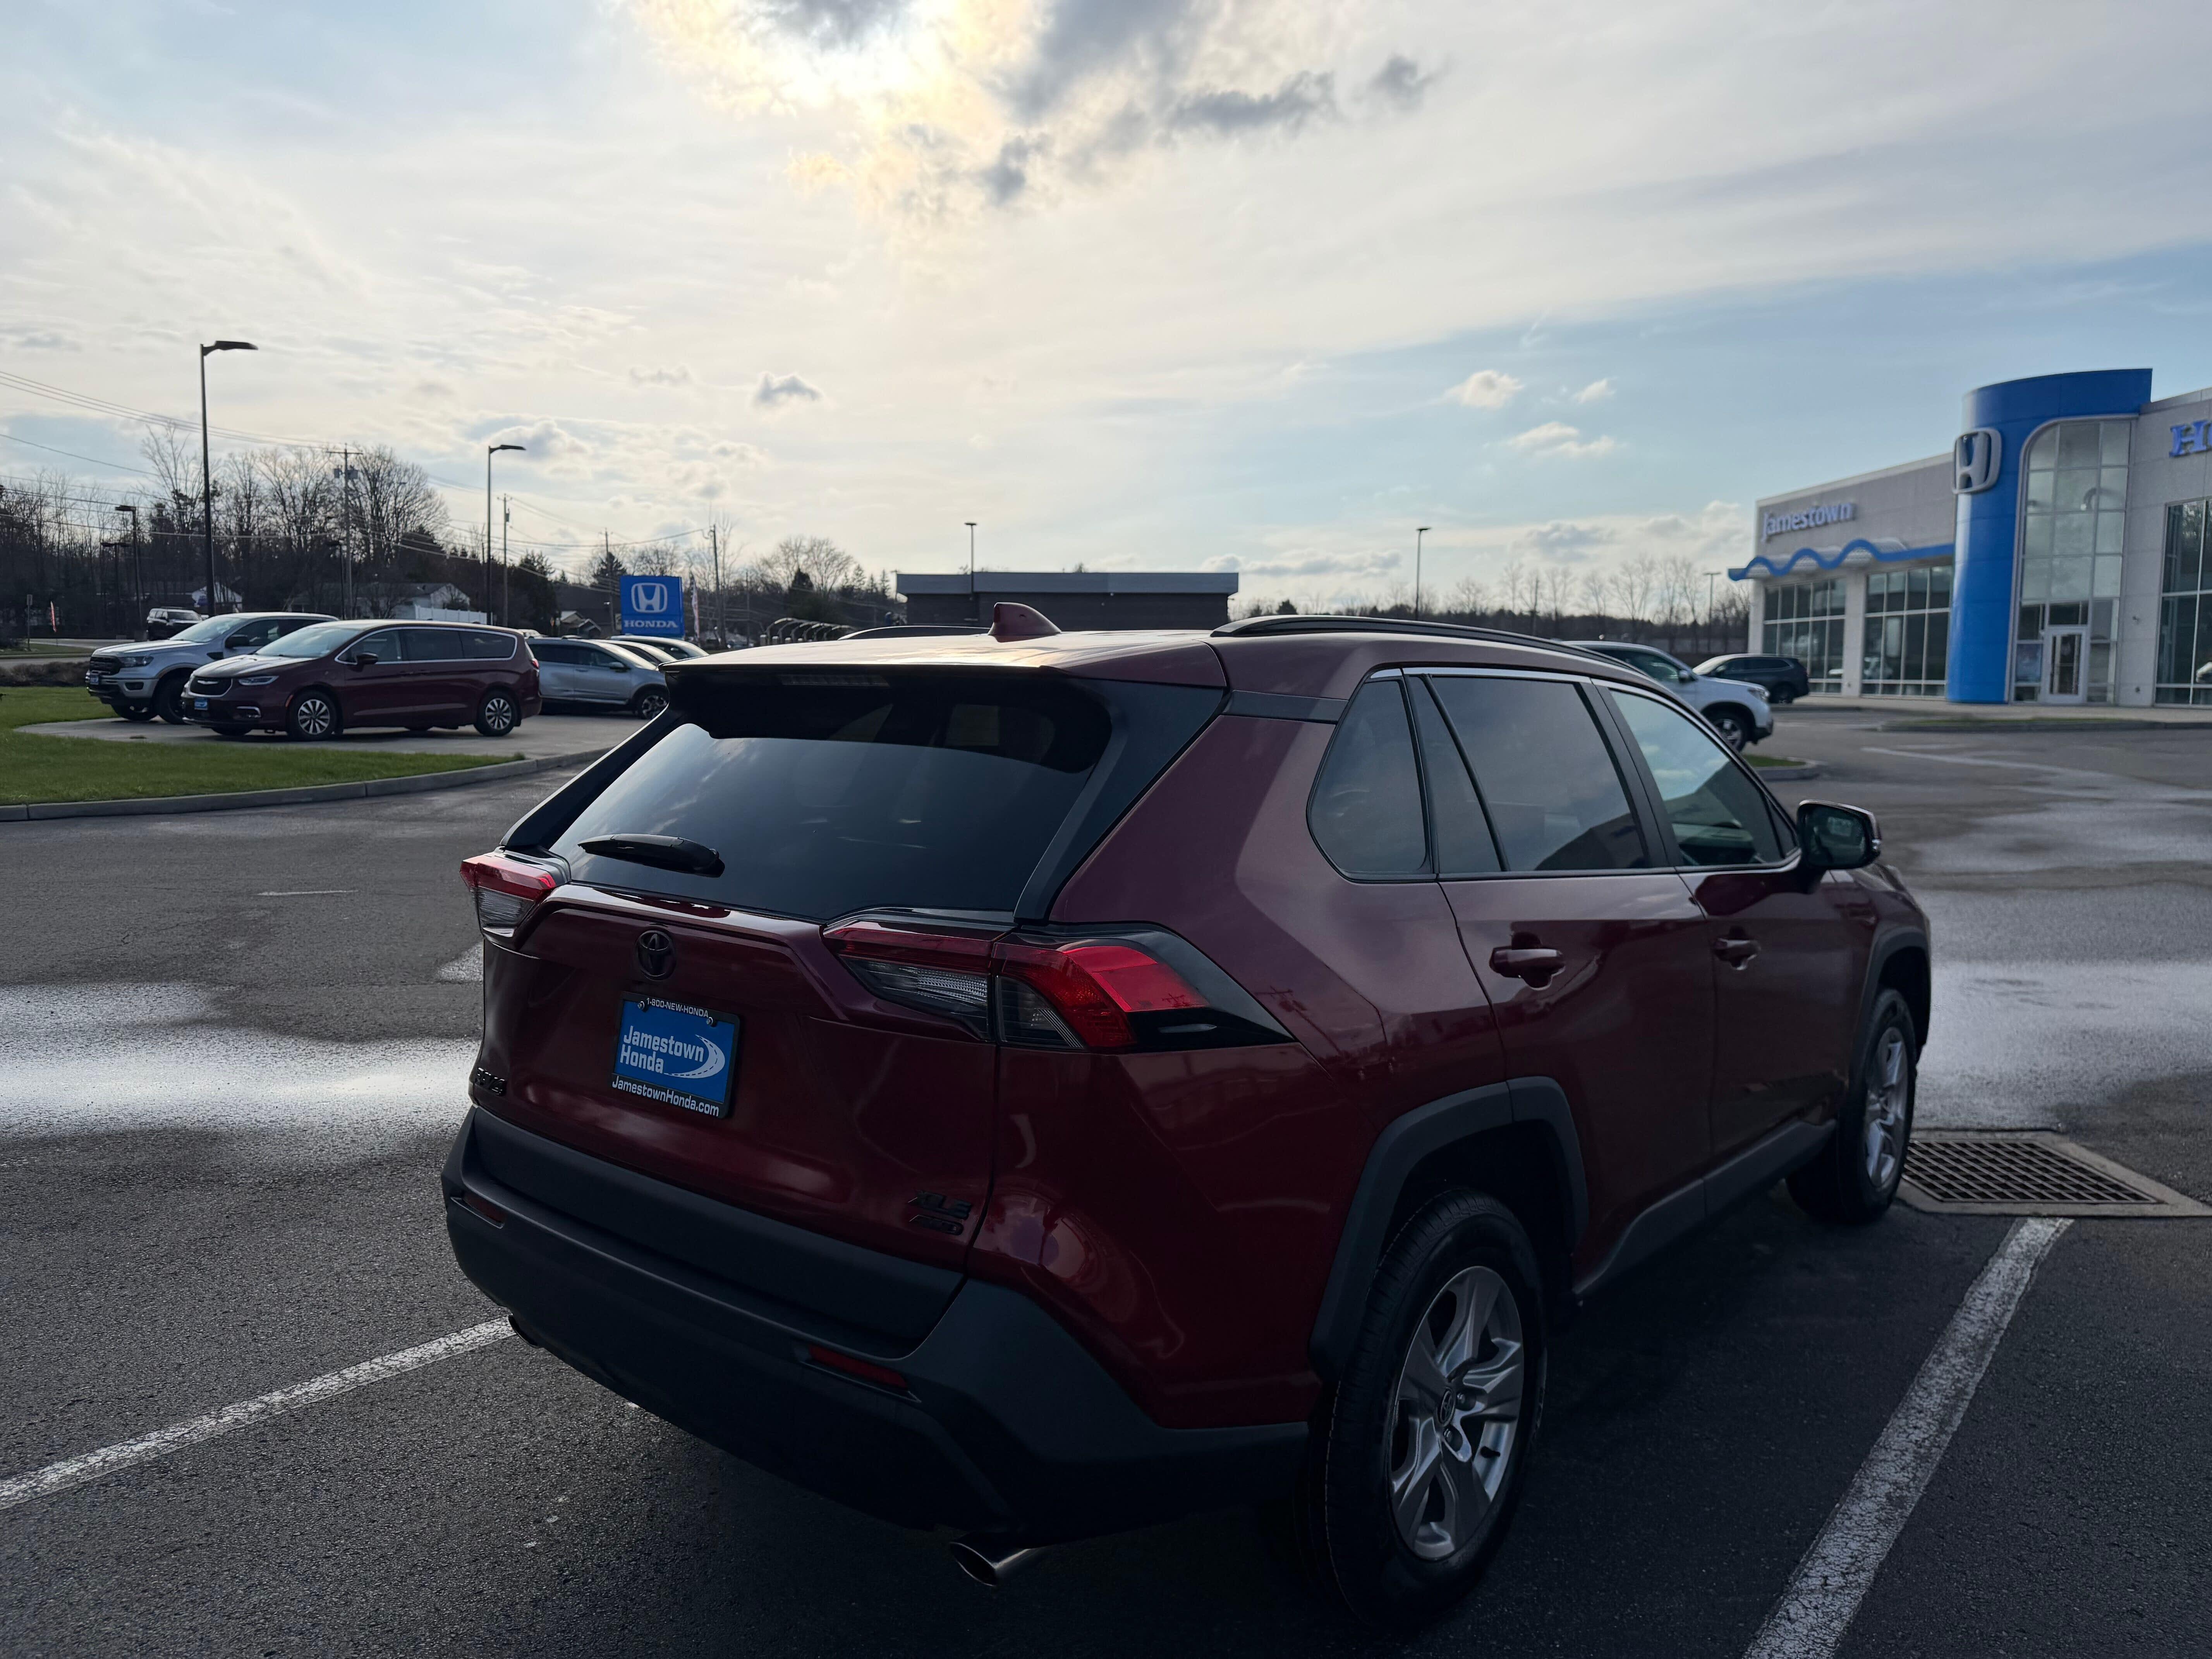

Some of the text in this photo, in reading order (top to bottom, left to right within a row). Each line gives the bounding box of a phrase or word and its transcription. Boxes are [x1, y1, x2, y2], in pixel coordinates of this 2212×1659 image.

[1761, 503, 1854, 543] Jamestown
[620, 1044, 664, 1073] Honda
[623, 1025, 704, 1062] Jamestown
[612, 1076, 720, 1117] JamestownHonda.com
